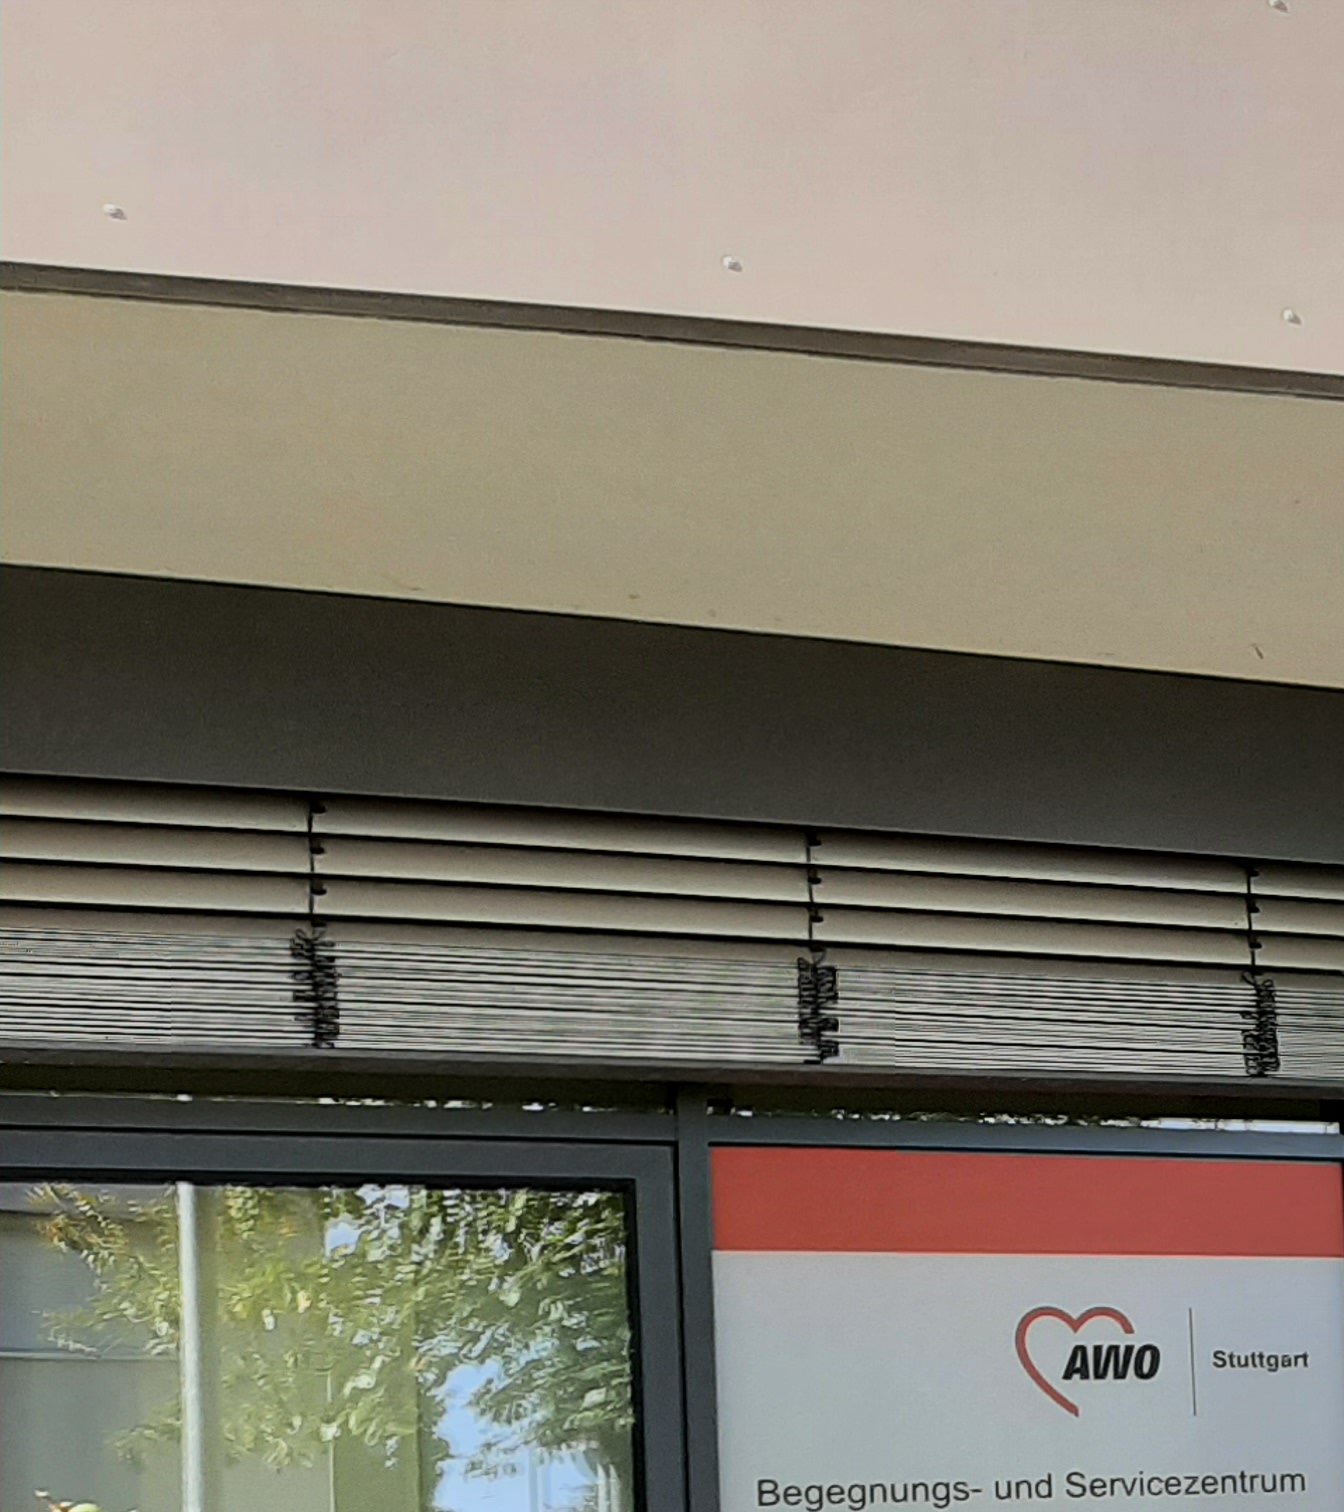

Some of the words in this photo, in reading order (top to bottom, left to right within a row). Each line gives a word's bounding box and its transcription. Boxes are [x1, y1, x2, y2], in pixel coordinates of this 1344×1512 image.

[1061, 1343, 1161, 1381] AWO
[1211, 1349, 1310, 1373] Stuttgart
[757, 1478, 983, 1512] Begegnungs-
[994, 1472, 1053, 1501] und
[1065, 1469, 1307, 1499] Servicezentrum
